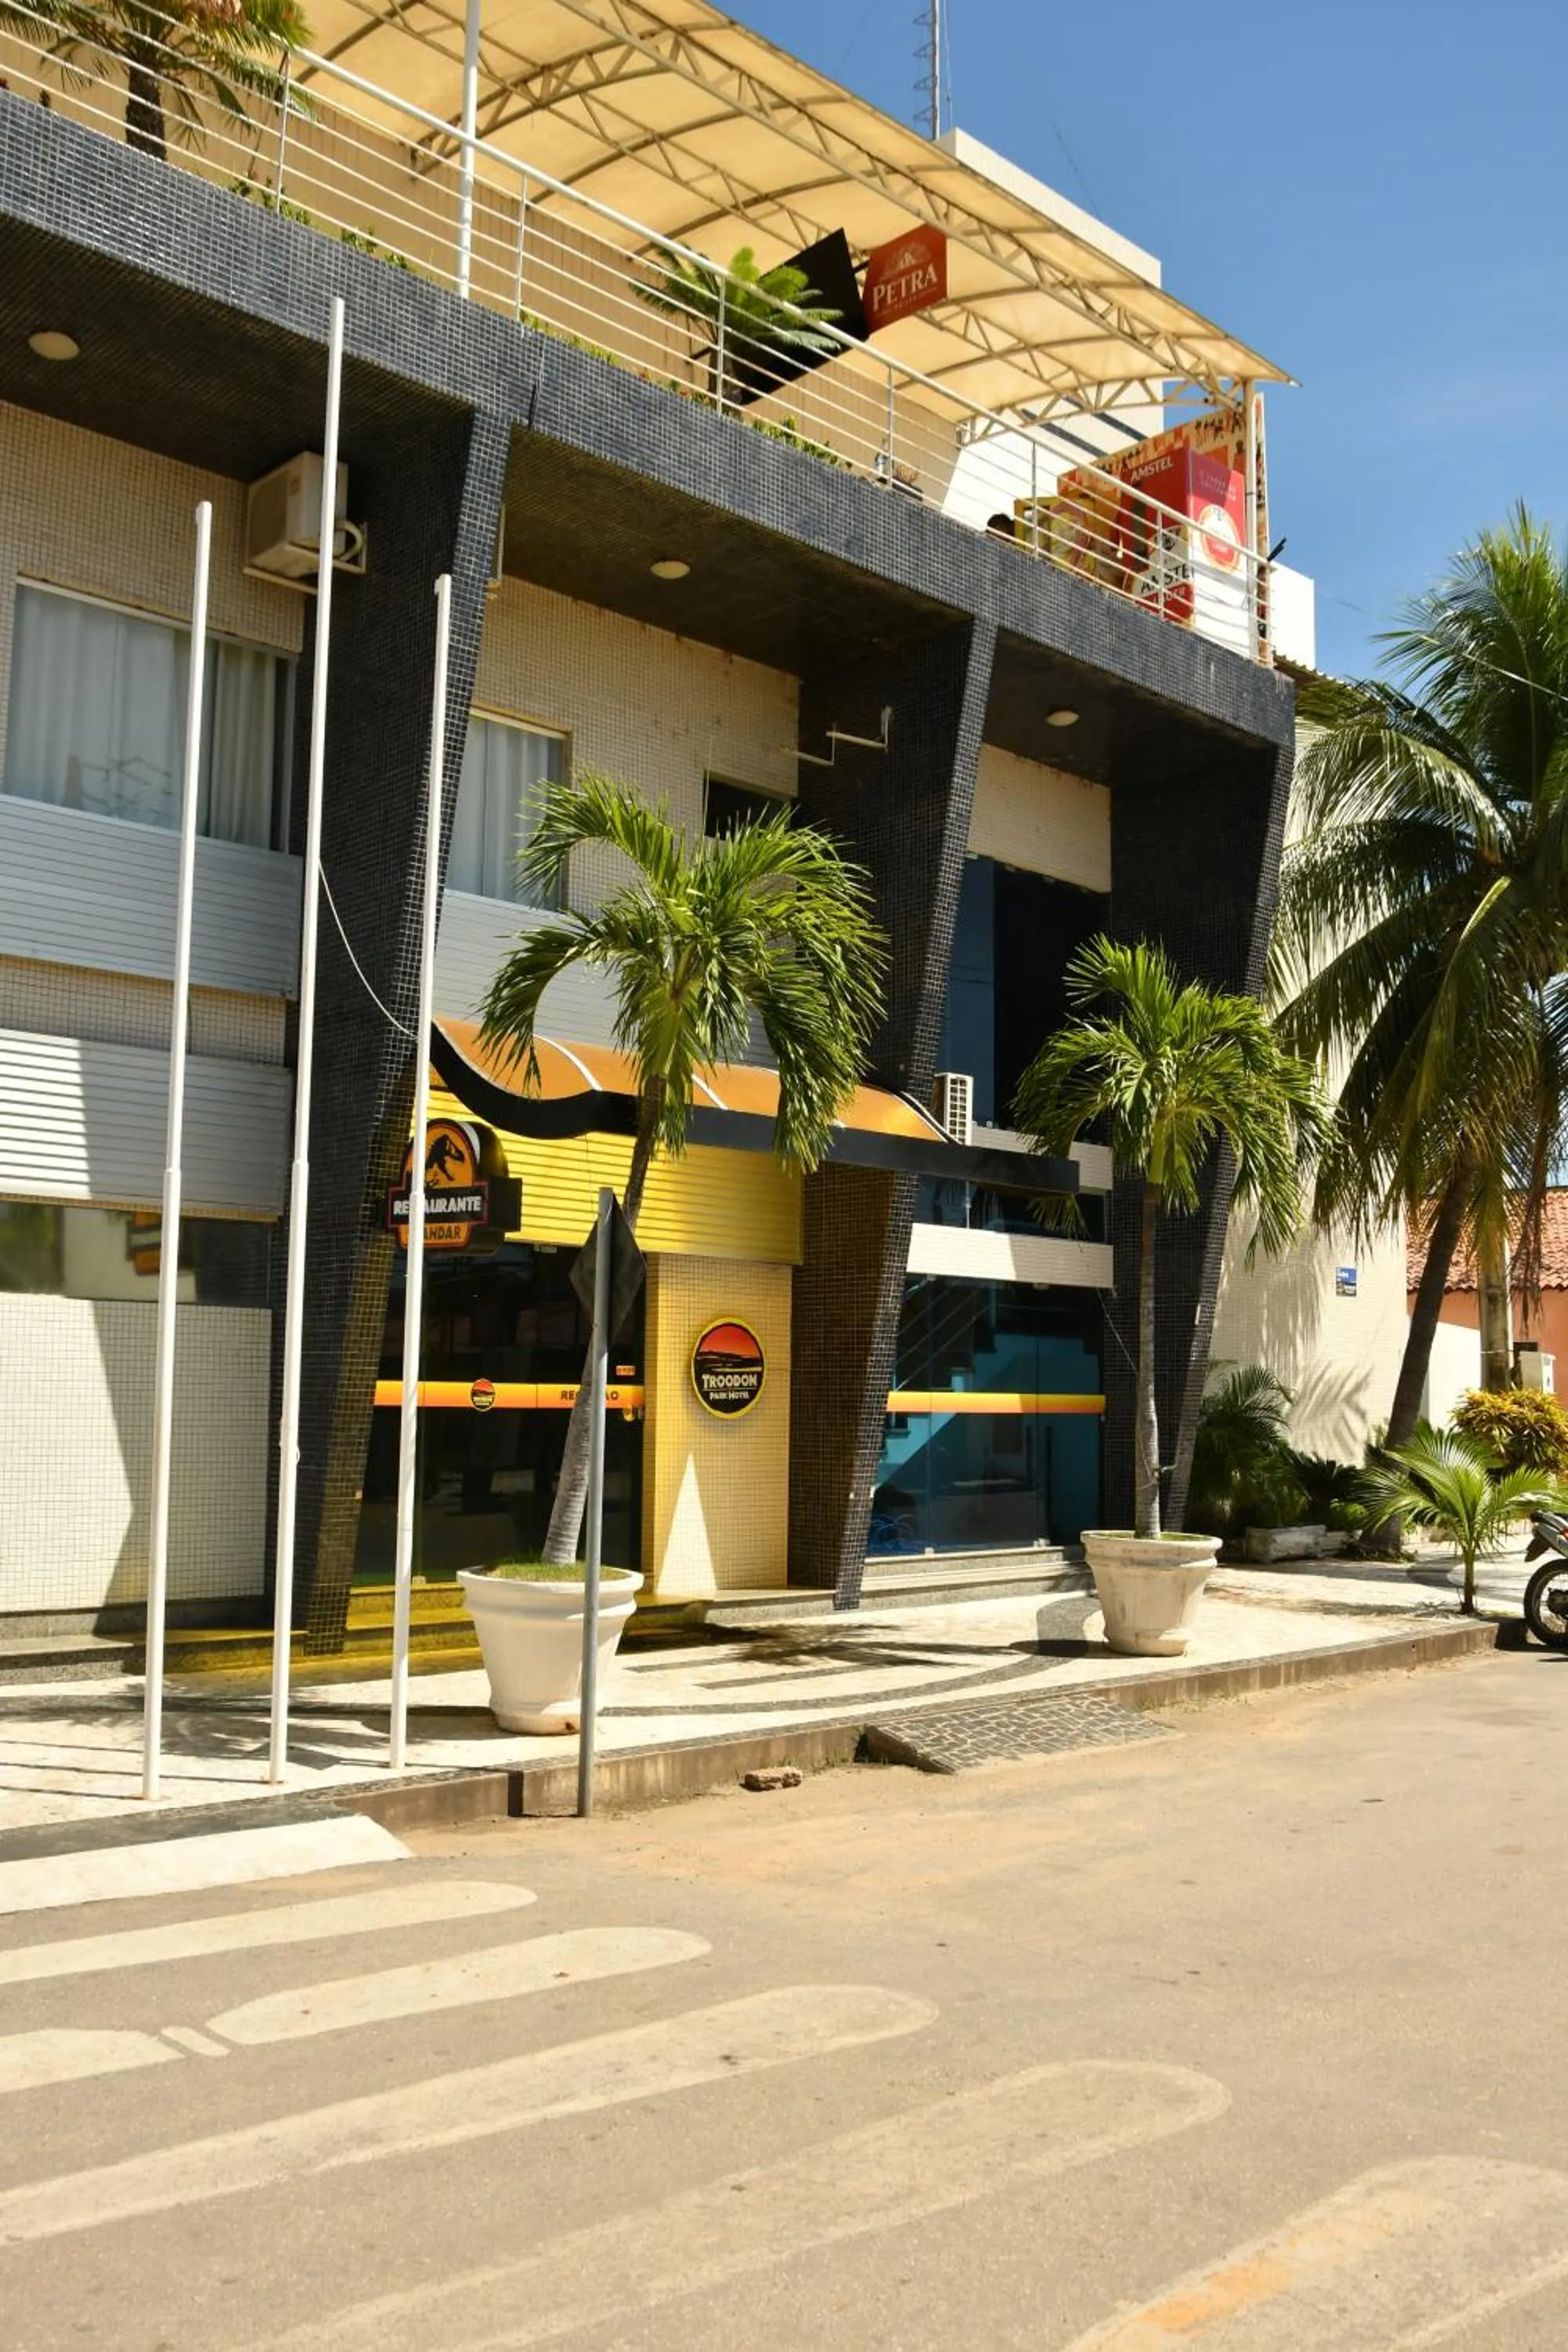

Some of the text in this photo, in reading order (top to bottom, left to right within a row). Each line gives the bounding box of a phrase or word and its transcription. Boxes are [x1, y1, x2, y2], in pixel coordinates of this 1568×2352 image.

[873, 263, 938, 311] PETRA
[1131, 456, 1173, 482] AMSTEL
[393, 1196, 482, 1215] REAURANTE
[702, 1374, 757, 1389] TROODON
[710, 1392, 728, 1400] PARK
